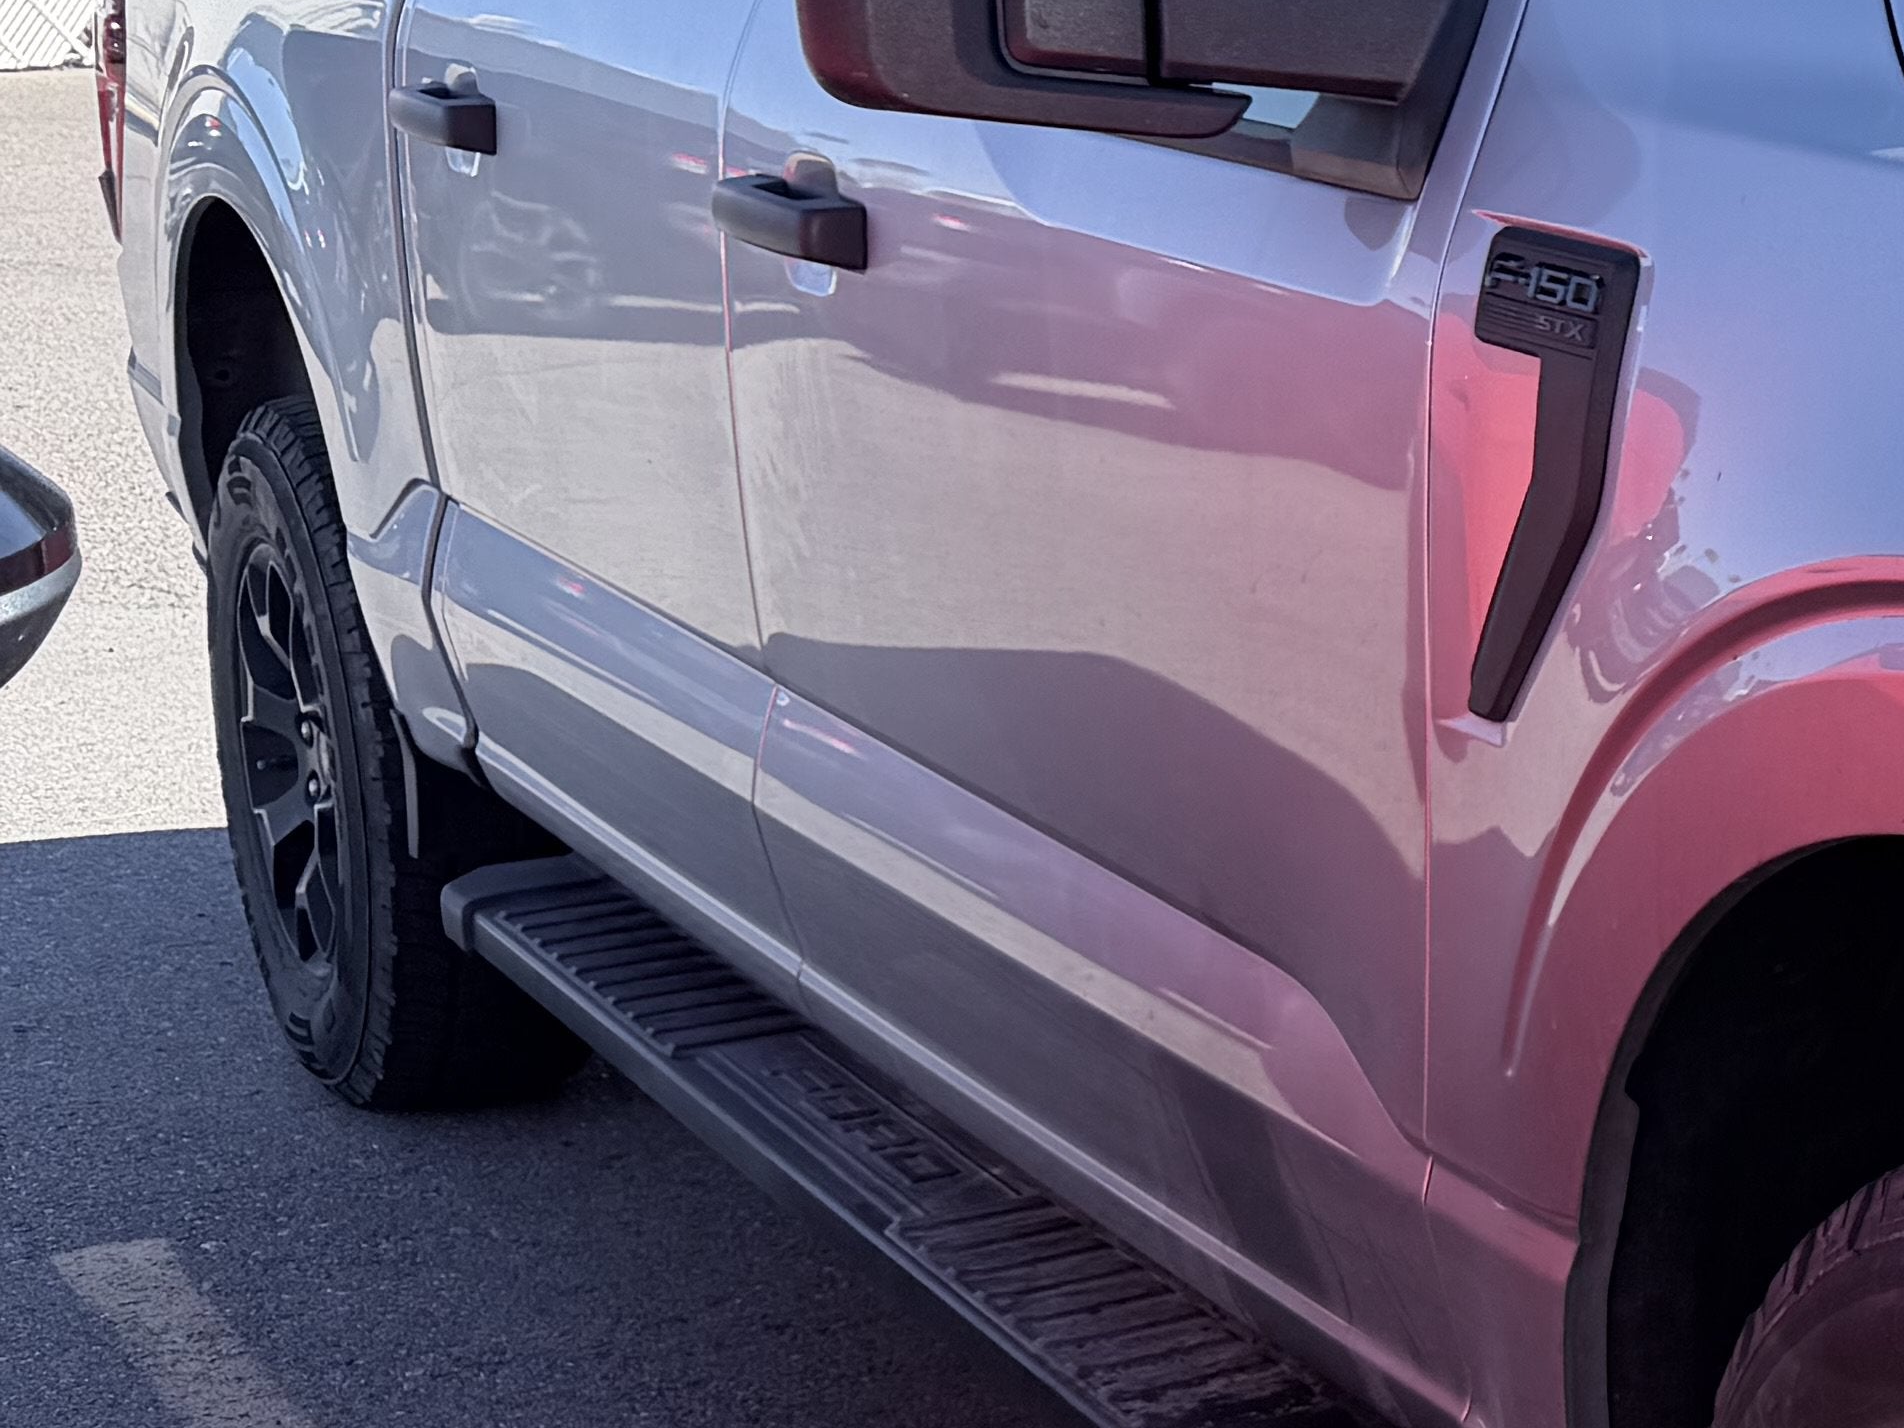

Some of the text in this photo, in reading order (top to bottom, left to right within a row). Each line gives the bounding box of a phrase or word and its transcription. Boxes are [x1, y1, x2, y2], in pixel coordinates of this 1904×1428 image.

[1485, 255, 1602, 313] F-150
[1534, 315, 1584, 342] STX
[763, 1066, 964, 1185] FORD
